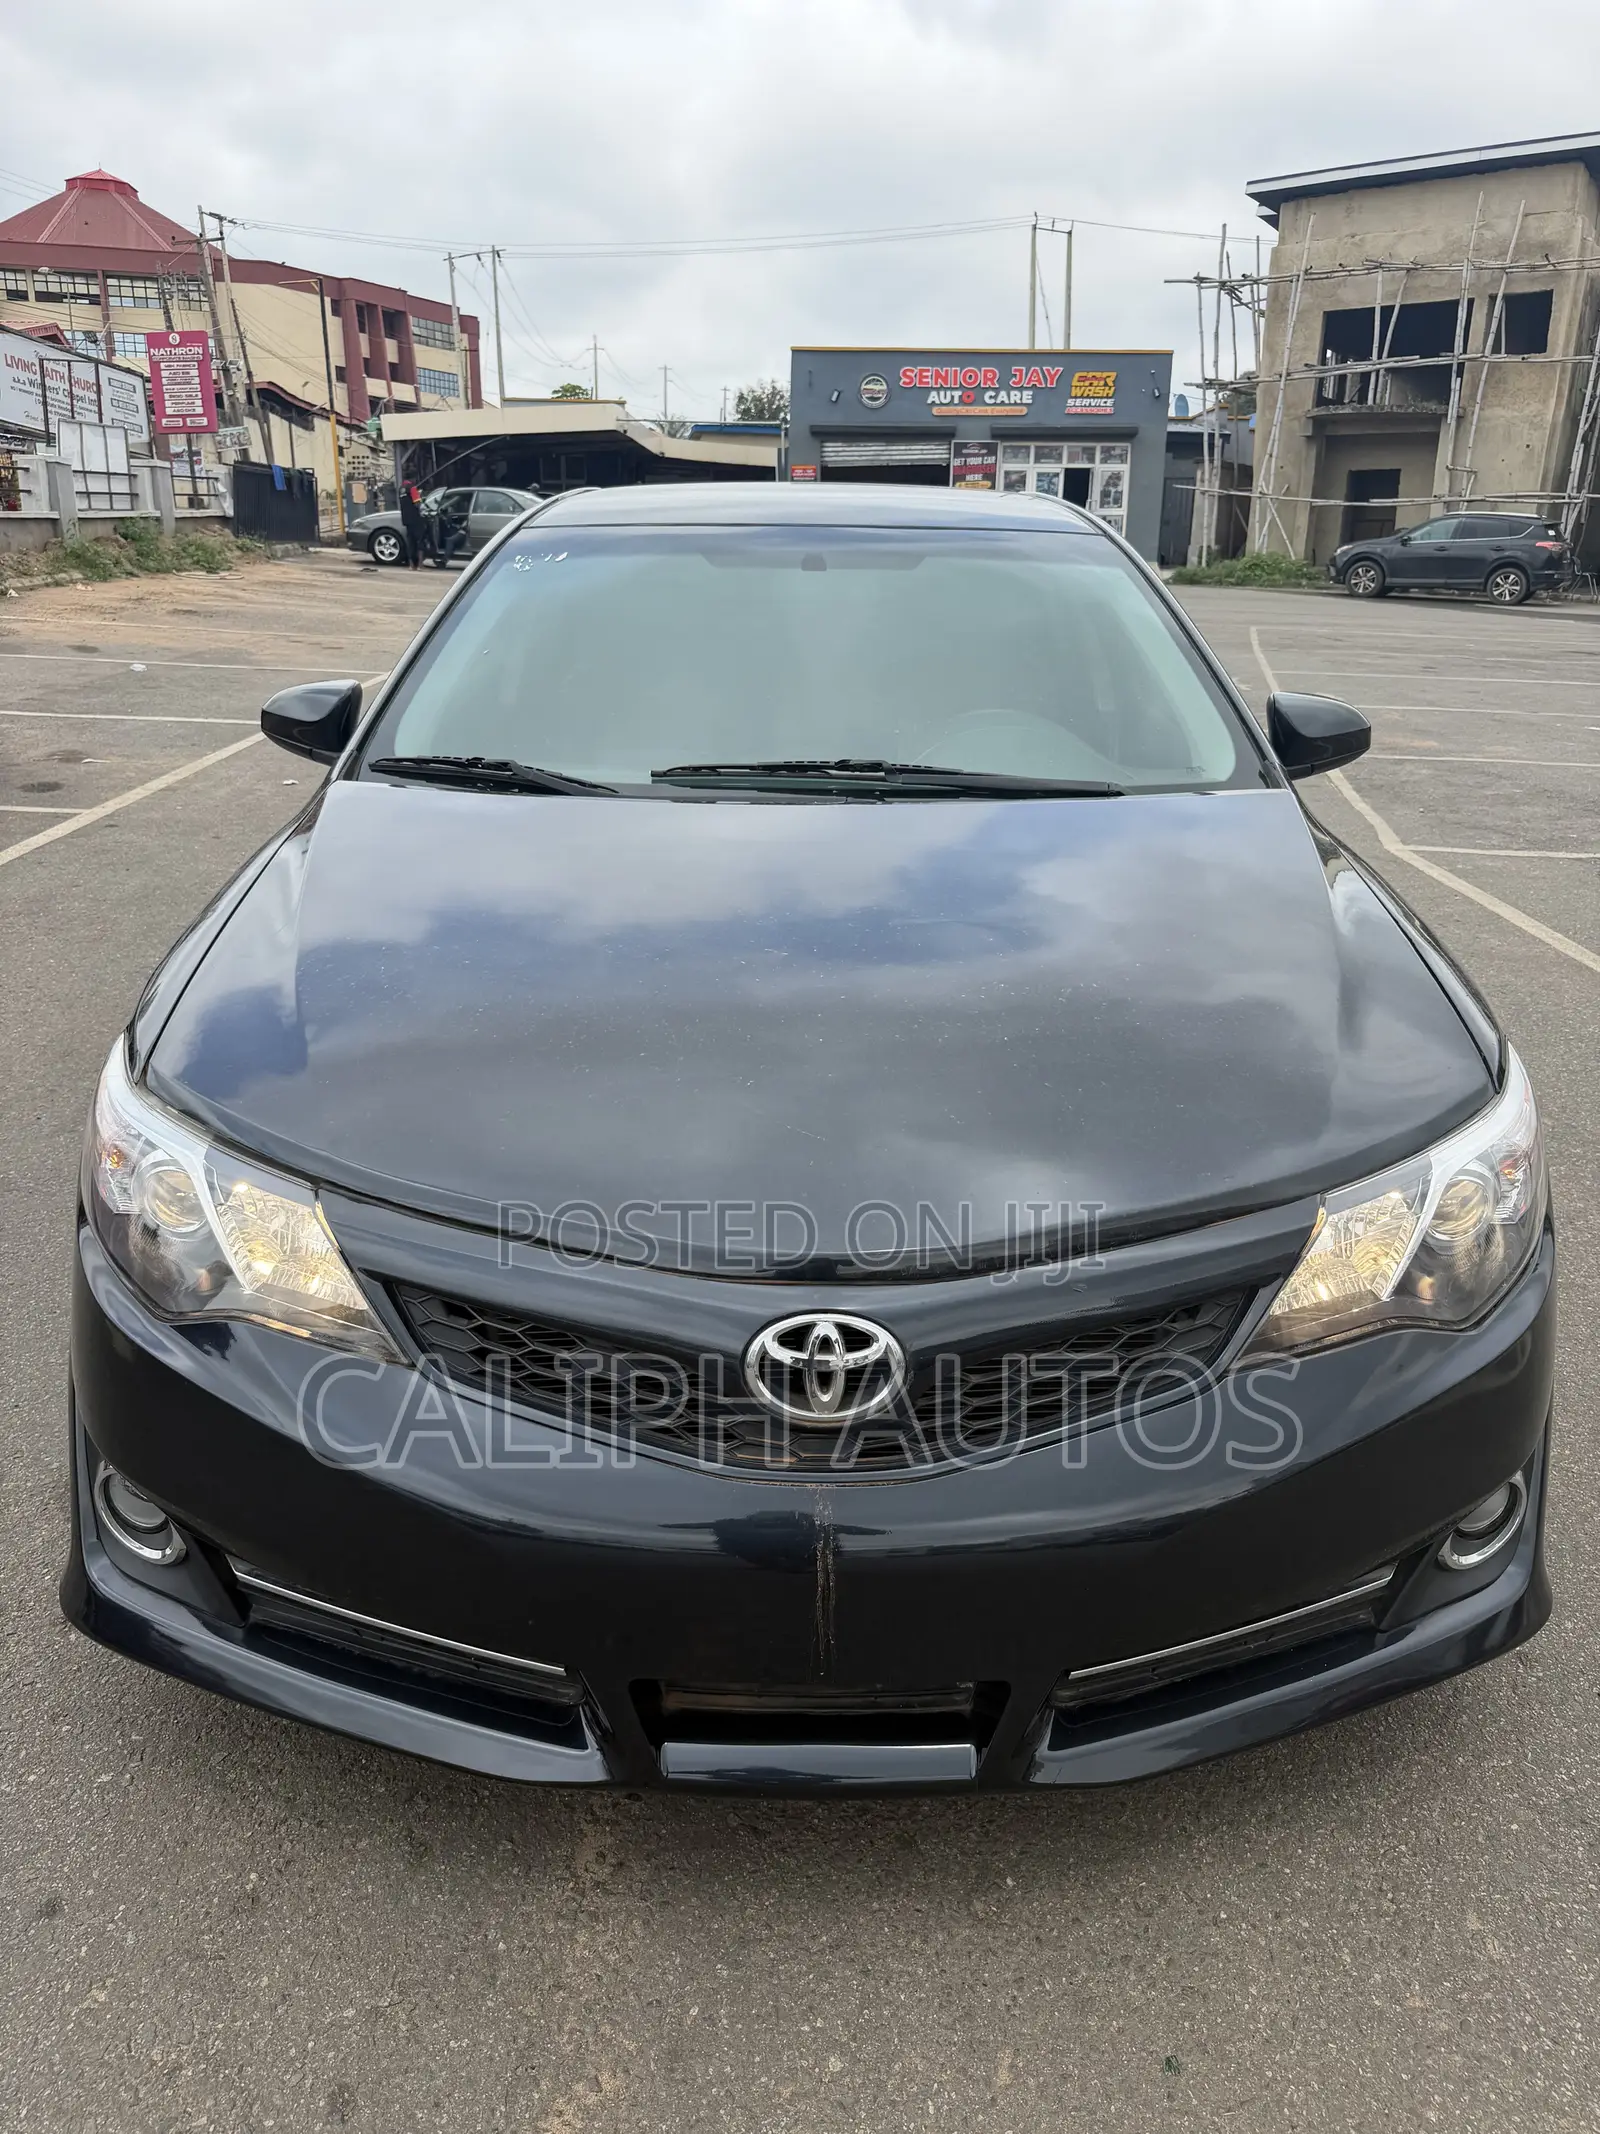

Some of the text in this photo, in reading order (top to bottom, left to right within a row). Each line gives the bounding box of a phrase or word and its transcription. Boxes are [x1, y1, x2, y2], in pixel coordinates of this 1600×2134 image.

[150, 346, 203, 356] NATHRON
[4, 353, 38, 376] LIVING
[43, 365, 66, 385] AITH
[70, 374, 104, 396] HURC
[900, 366, 1064, 388] SENIOR JAY
[1072, 371, 1117, 387] CAR
[927, 390, 1033, 404] AUTO CARE
[1071, 386, 1116, 397] WASH
[1066, 398, 1115, 407] SERVICE
